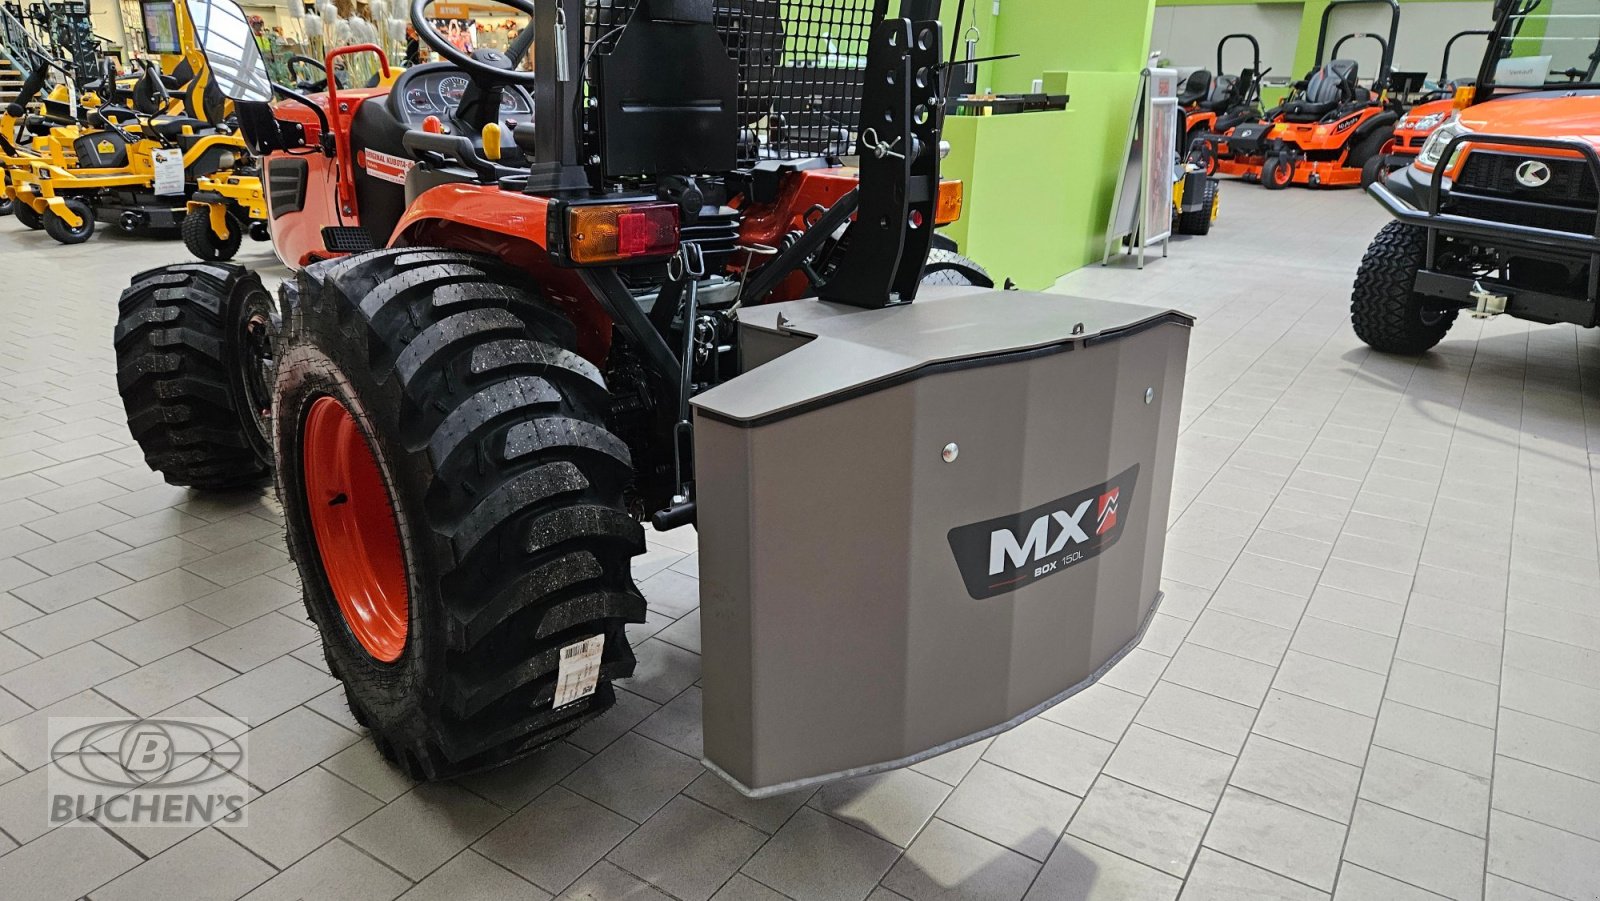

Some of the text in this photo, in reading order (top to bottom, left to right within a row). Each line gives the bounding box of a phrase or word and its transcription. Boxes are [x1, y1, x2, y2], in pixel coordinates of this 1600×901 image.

[989, 498, 1094, 576] MX
[1034, 550, 1084, 578] BOX 150L
